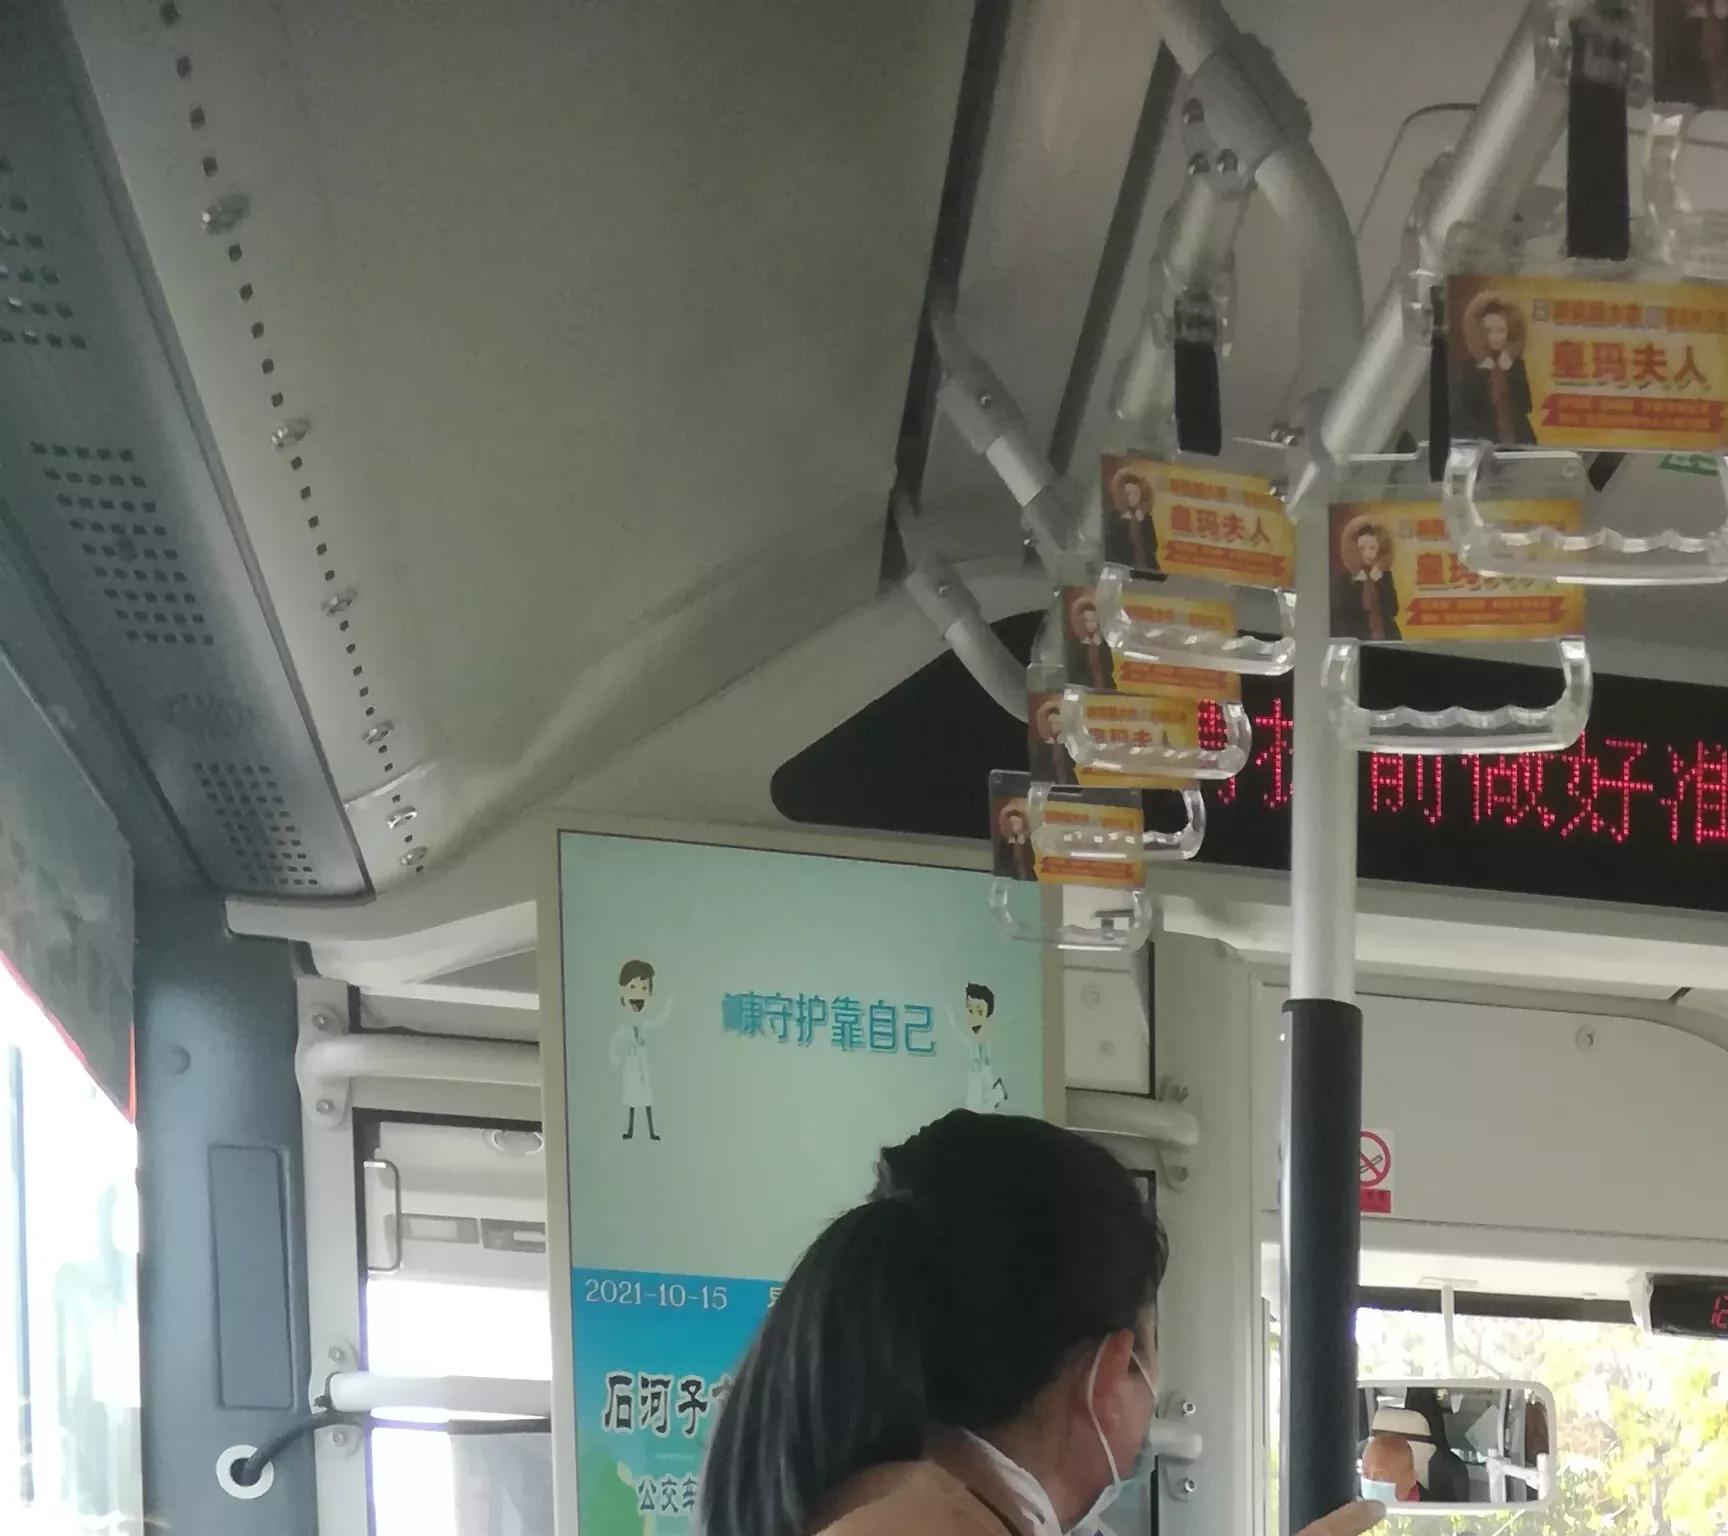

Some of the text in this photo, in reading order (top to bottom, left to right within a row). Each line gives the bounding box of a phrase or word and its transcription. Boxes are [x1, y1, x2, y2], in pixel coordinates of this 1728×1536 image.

[585, 1279, 728, 1311] 2021-10-15
[604, 1374, 735, 1434] 石河子
